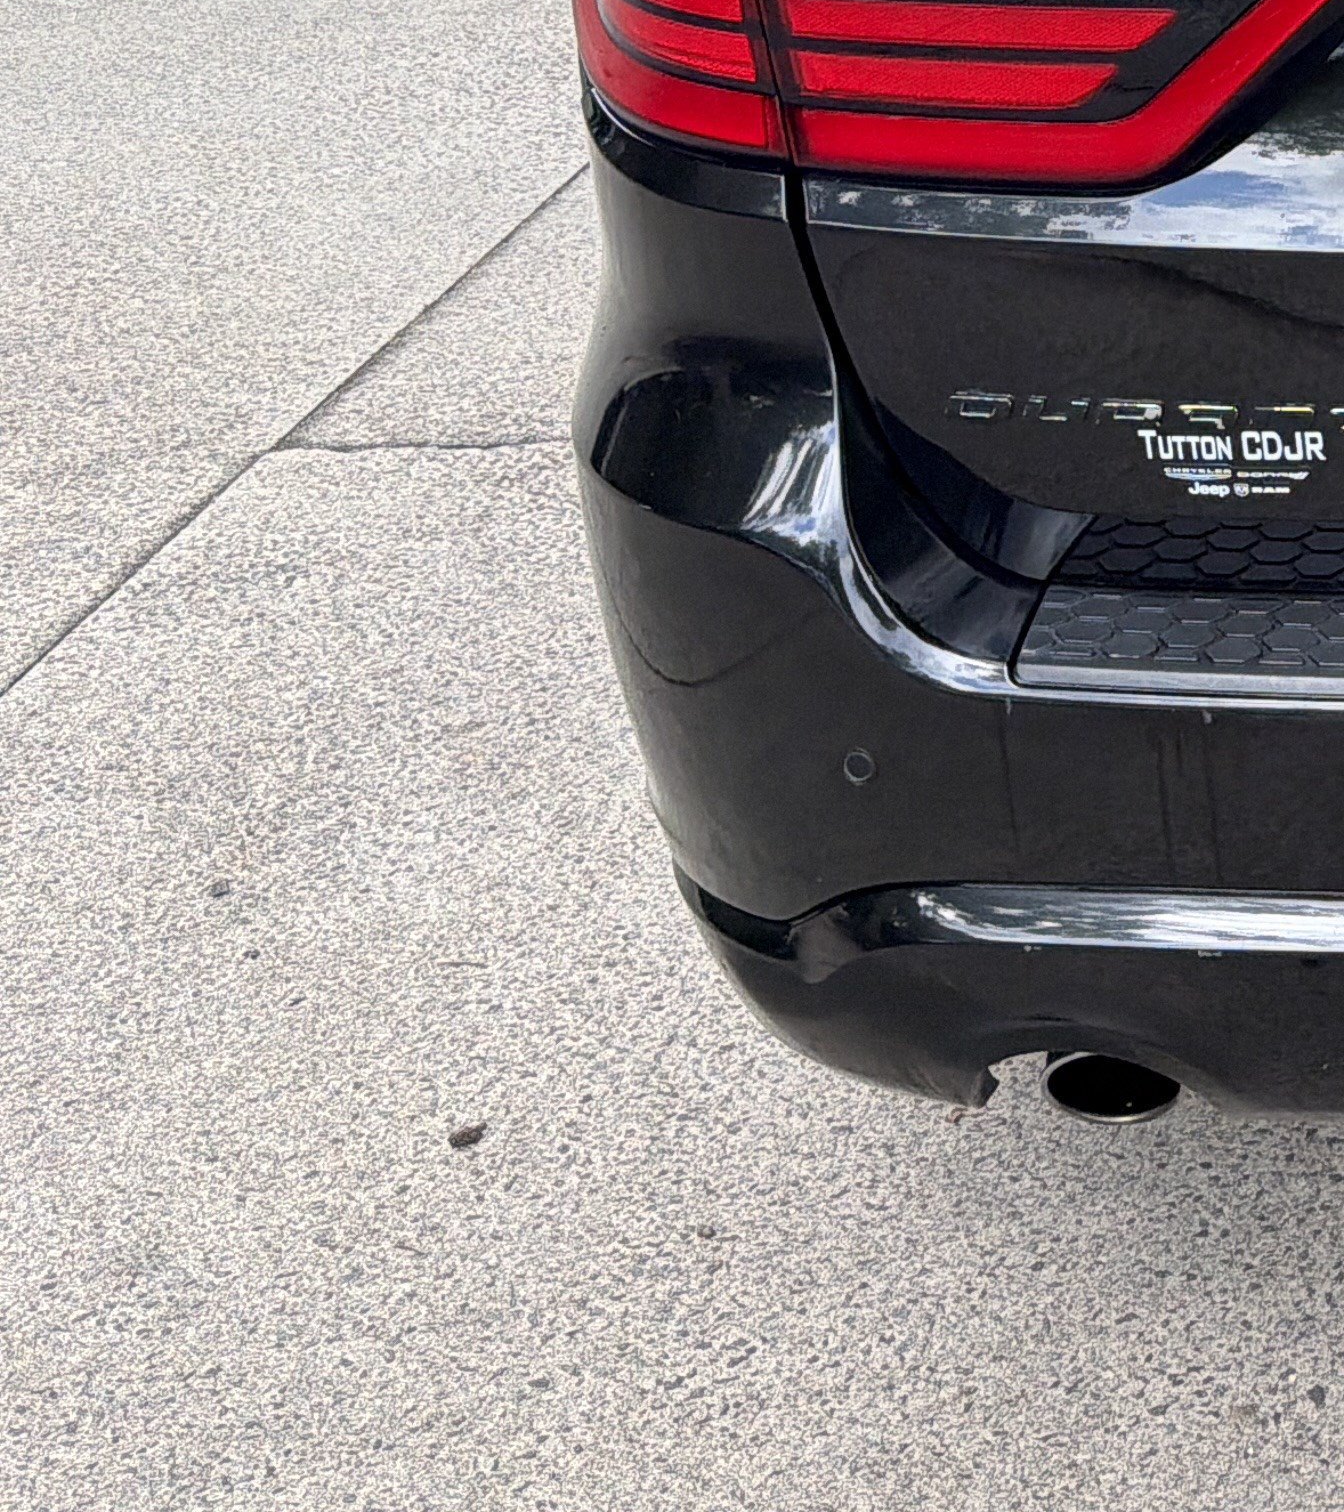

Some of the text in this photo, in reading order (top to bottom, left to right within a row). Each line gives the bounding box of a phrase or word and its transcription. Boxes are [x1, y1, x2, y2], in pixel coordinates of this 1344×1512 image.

[1240, 430, 1327, 461] CDJR
[1188, 481, 1291, 498] Jeep RAM
